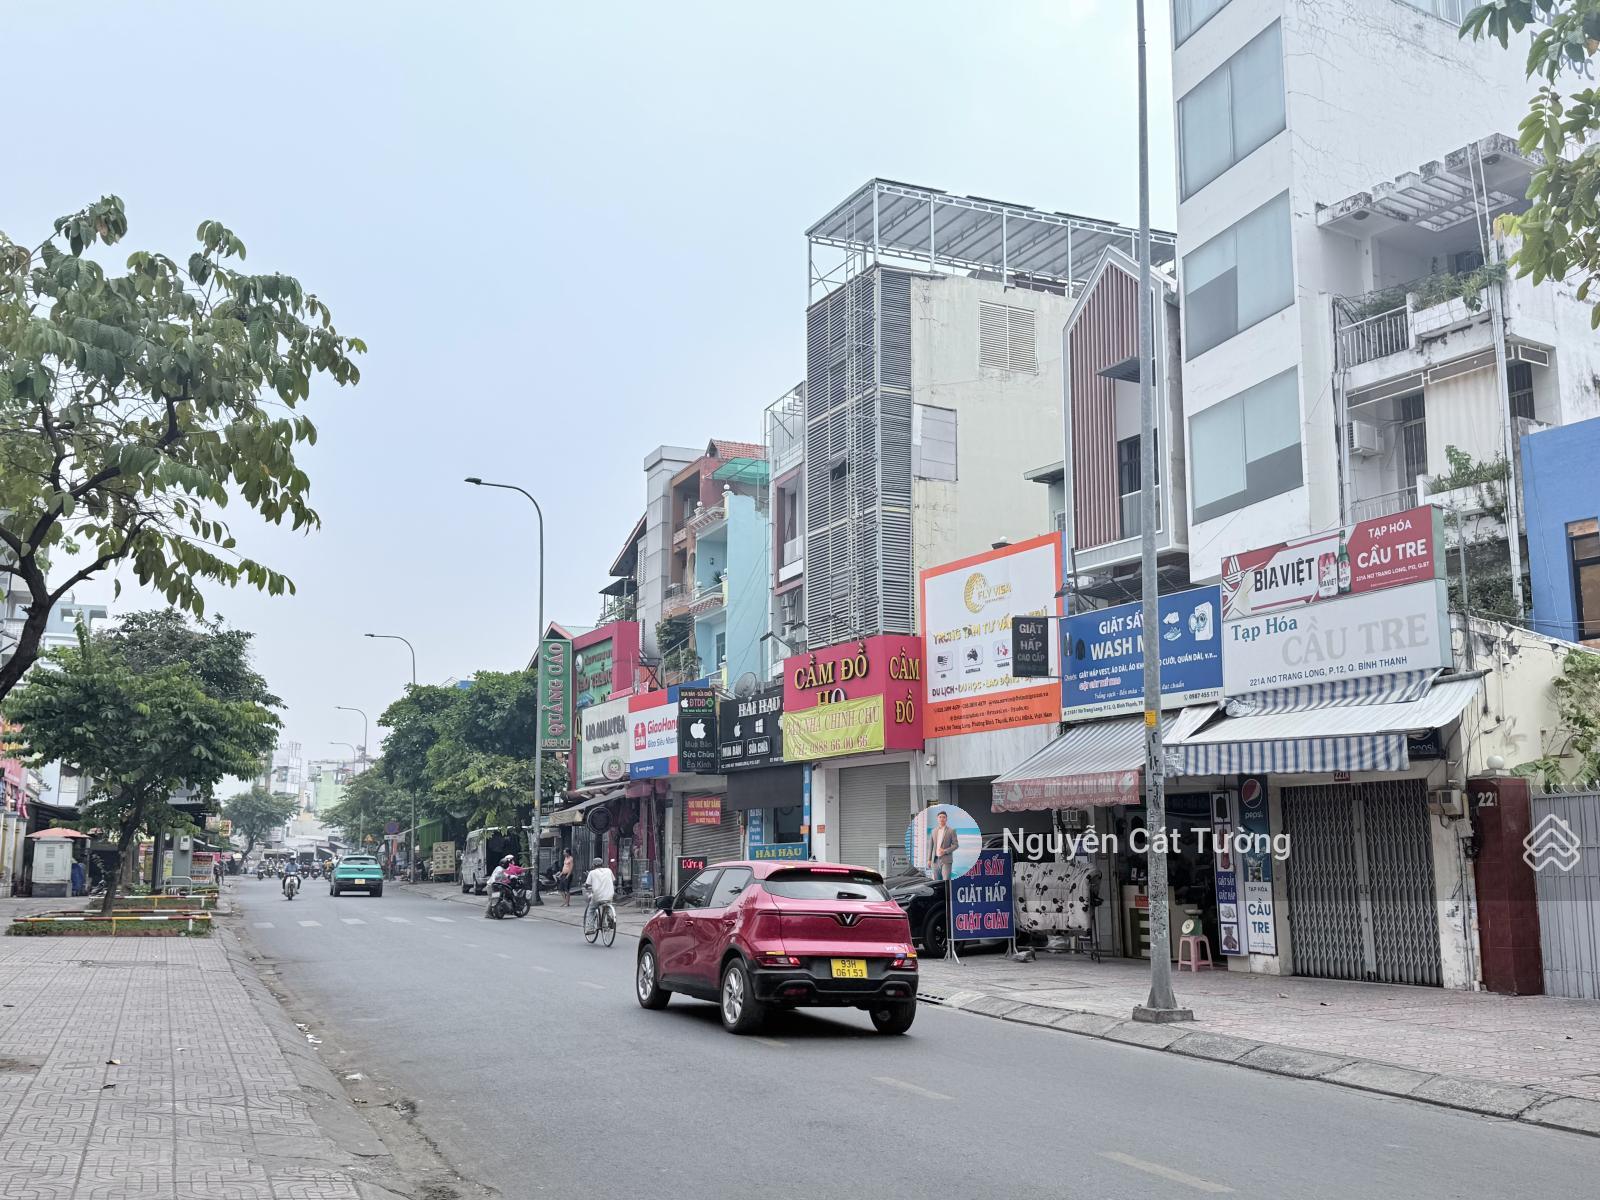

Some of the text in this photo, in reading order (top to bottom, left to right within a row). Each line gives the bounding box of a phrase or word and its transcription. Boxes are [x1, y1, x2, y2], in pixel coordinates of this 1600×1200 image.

[1368, 518, 1412, 539] TẠP HÓA
[1357, 538, 1427, 569] CẦU TRE
[1019, 622, 1044, 638] GIẶT
[1099, 616, 1124, 637] GIẶT
[1231, 615, 1298, 643] Tạp Hóa
[1020, 637, 1043, 651] HẤP
[1090, 637, 1133, 661] WASH
[1281, 613, 1430, 667] CẦU TRE
[794, 642, 868, 689] CẦM ĐỒ
[889, 646, 921, 680] CẦM
[1279, 671, 1303, 682] TRANG
[1358, 659, 1377, 671] BÌNH
[1379, 655, 1408, 668] THẠNH
[541, 642, 567, 738] QUẢNG CÁO
[895, 688, 915, 724] ĐỒ
[1245, 811, 1263, 819] pepsi
[985, 853, 1005, 875] SẤY
[957, 882, 1007, 906] GIẶT HẤP
[1248, 897, 1272, 916] CẦU
[955, 908, 1010, 934] GIẶT GIÀY
[1252, 921, 1270, 934] TRE
[840, 959, 857, 969] 93H
